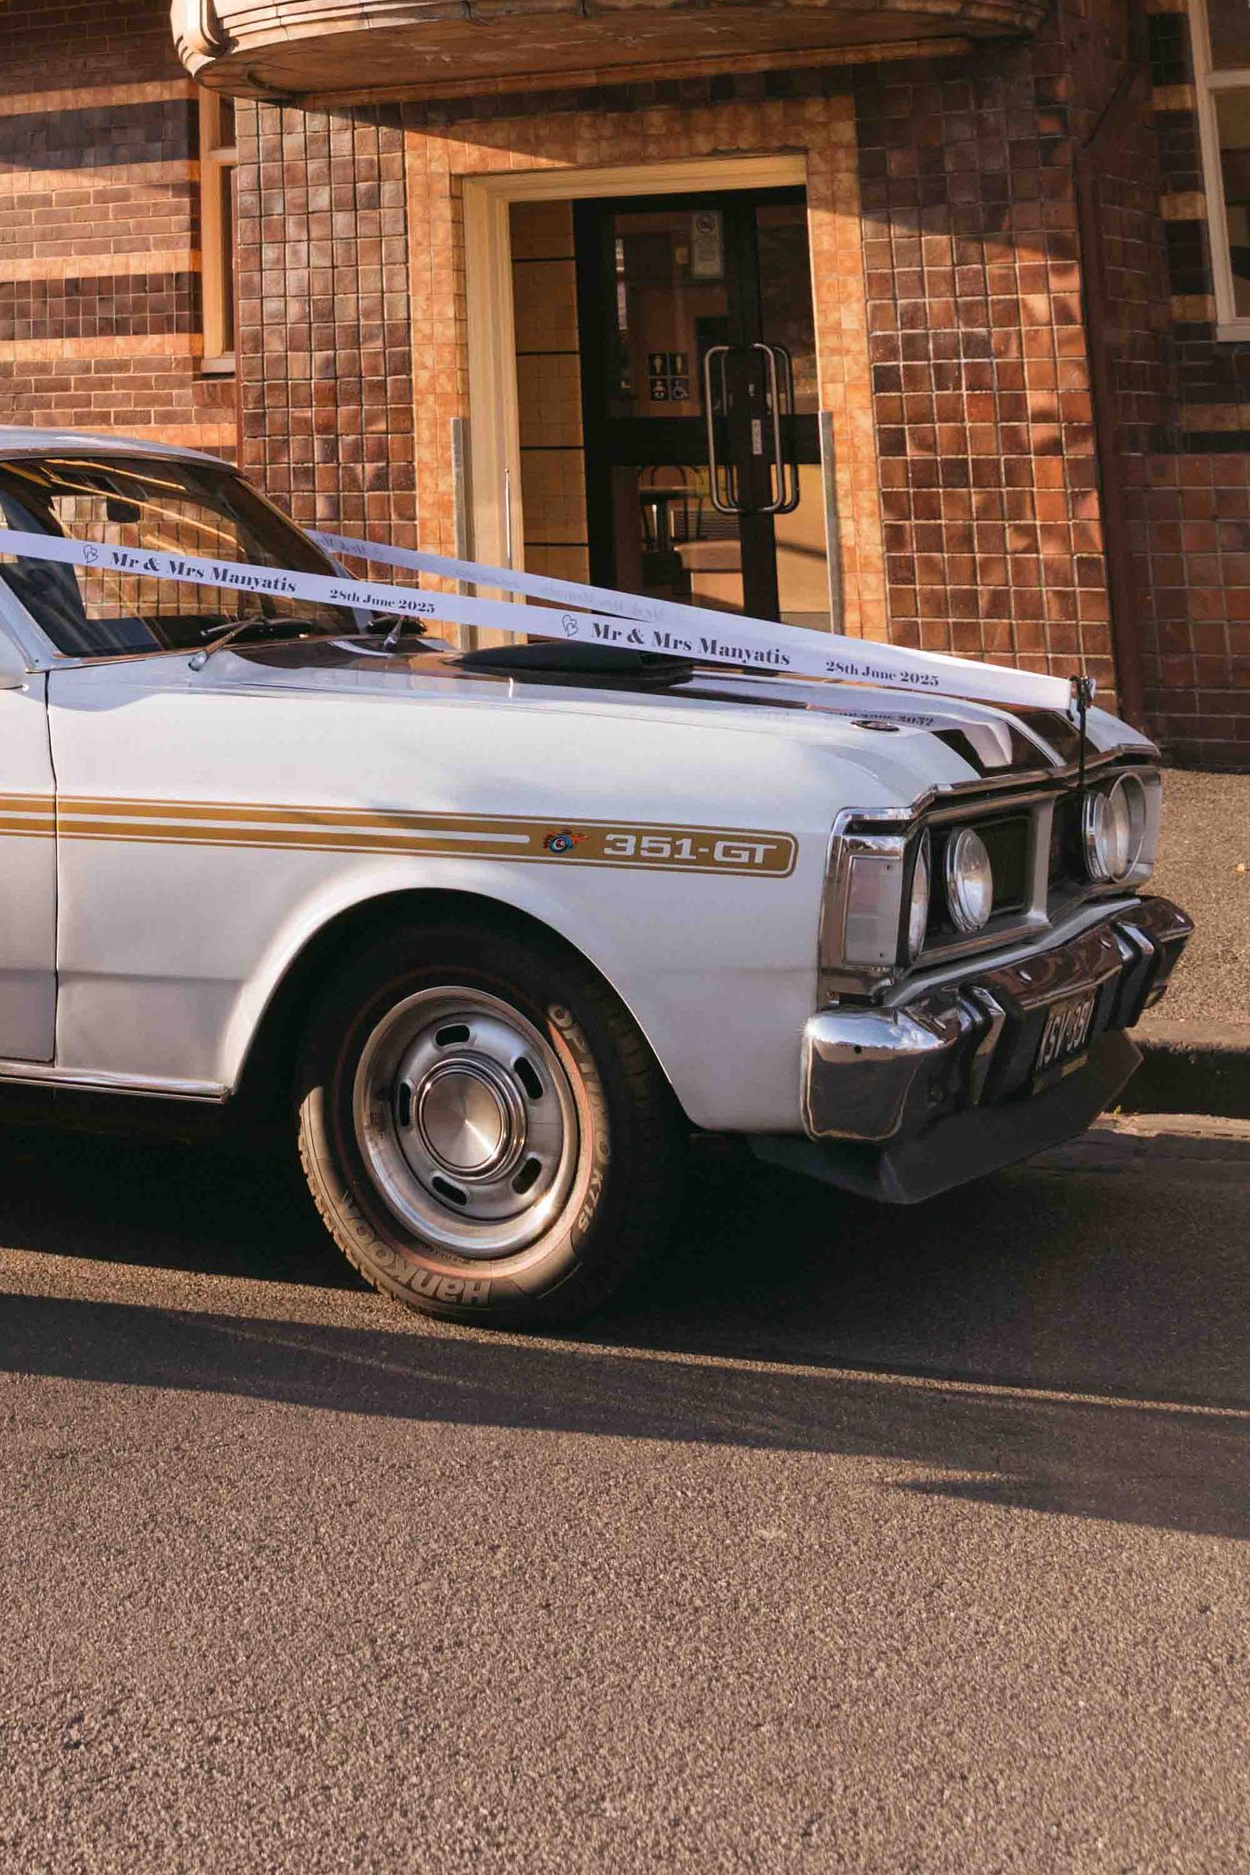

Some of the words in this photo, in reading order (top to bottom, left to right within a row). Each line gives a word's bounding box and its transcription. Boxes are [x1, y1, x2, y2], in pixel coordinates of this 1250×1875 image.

[110, 551, 139, 568] Mr
[143, 557, 160, 572] &
[166, 559, 205, 578] Mrs
[210, 566, 297, 592] Manyatis
[329, 588, 361, 603] 28th
[362, 594, 396, 607] June
[399, 599, 436, 614] 2025
[590, 622, 622, 641] Mr
[626, 627, 645, 645] &
[651, 630, 692, 652] Mrs
[697, 637, 791, 665] Manyatis
[826, 660, 859, 676] 28th
[861, 665, 897, 681] June
[900, 671, 939, 687] 2025
[602, 832, 779, 864] 351-GT
